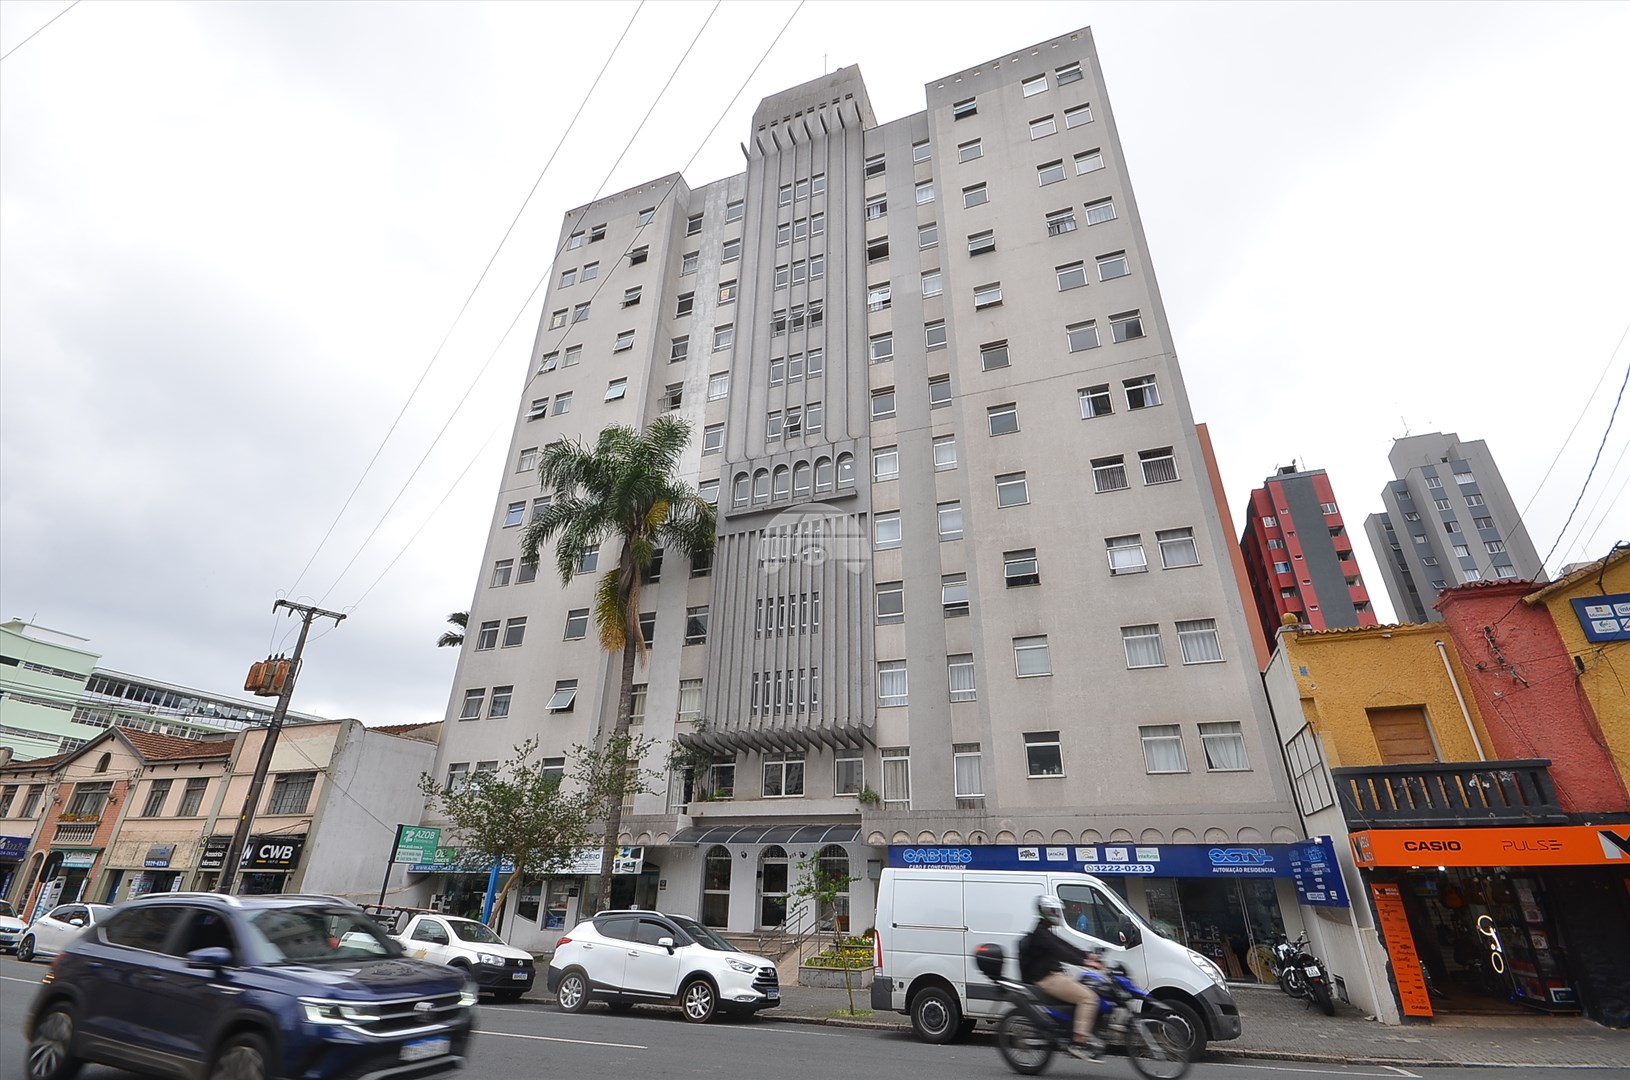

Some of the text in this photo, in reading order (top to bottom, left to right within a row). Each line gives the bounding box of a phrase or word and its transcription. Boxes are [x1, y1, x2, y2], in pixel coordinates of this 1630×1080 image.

[415, 830, 436, 840] AZOB
[1404, 841, 1461, 851] CASIO
[1502, 840, 1563, 850] PULSE
[260, 845, 294, 859] CWB
[903, 849, 972, 863] CABTEC
